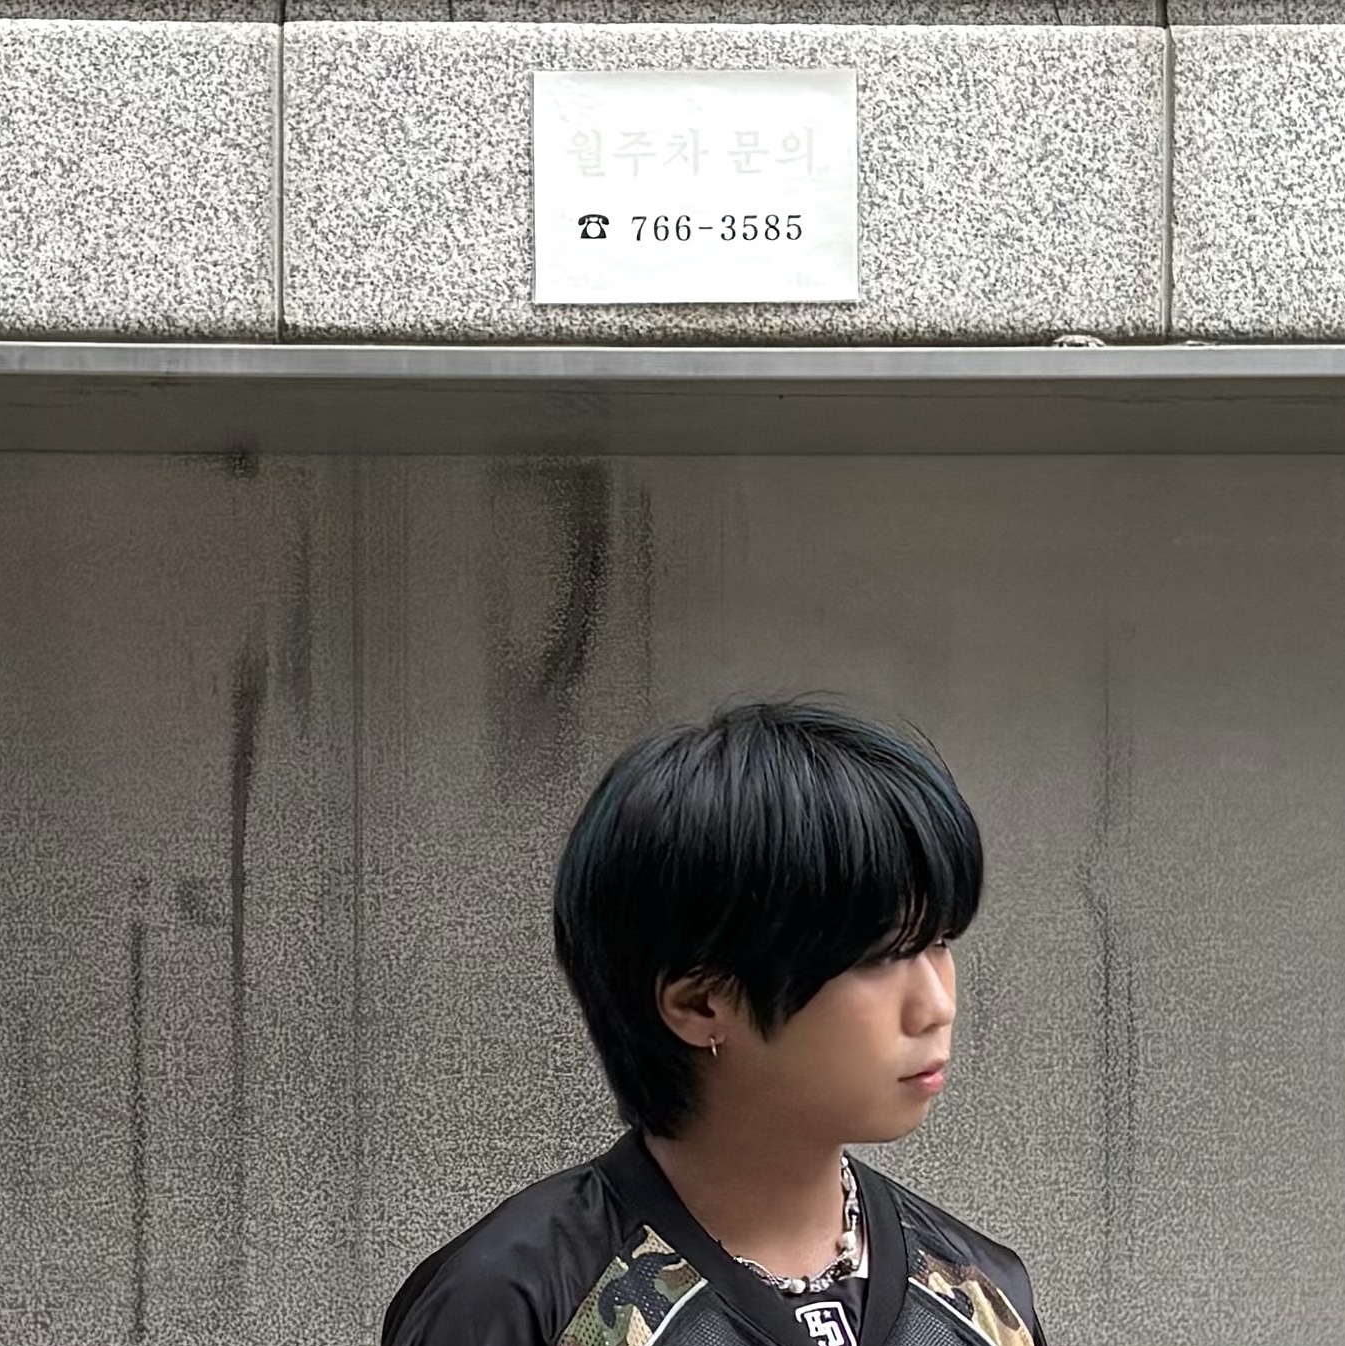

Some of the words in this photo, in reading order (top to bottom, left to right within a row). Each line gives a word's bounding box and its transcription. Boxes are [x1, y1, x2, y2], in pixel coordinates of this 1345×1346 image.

[565, 128, 708, 177] 월주차
[727, 127, 815, 175] 문의
[631, 214, 803, 241] 766-3585
